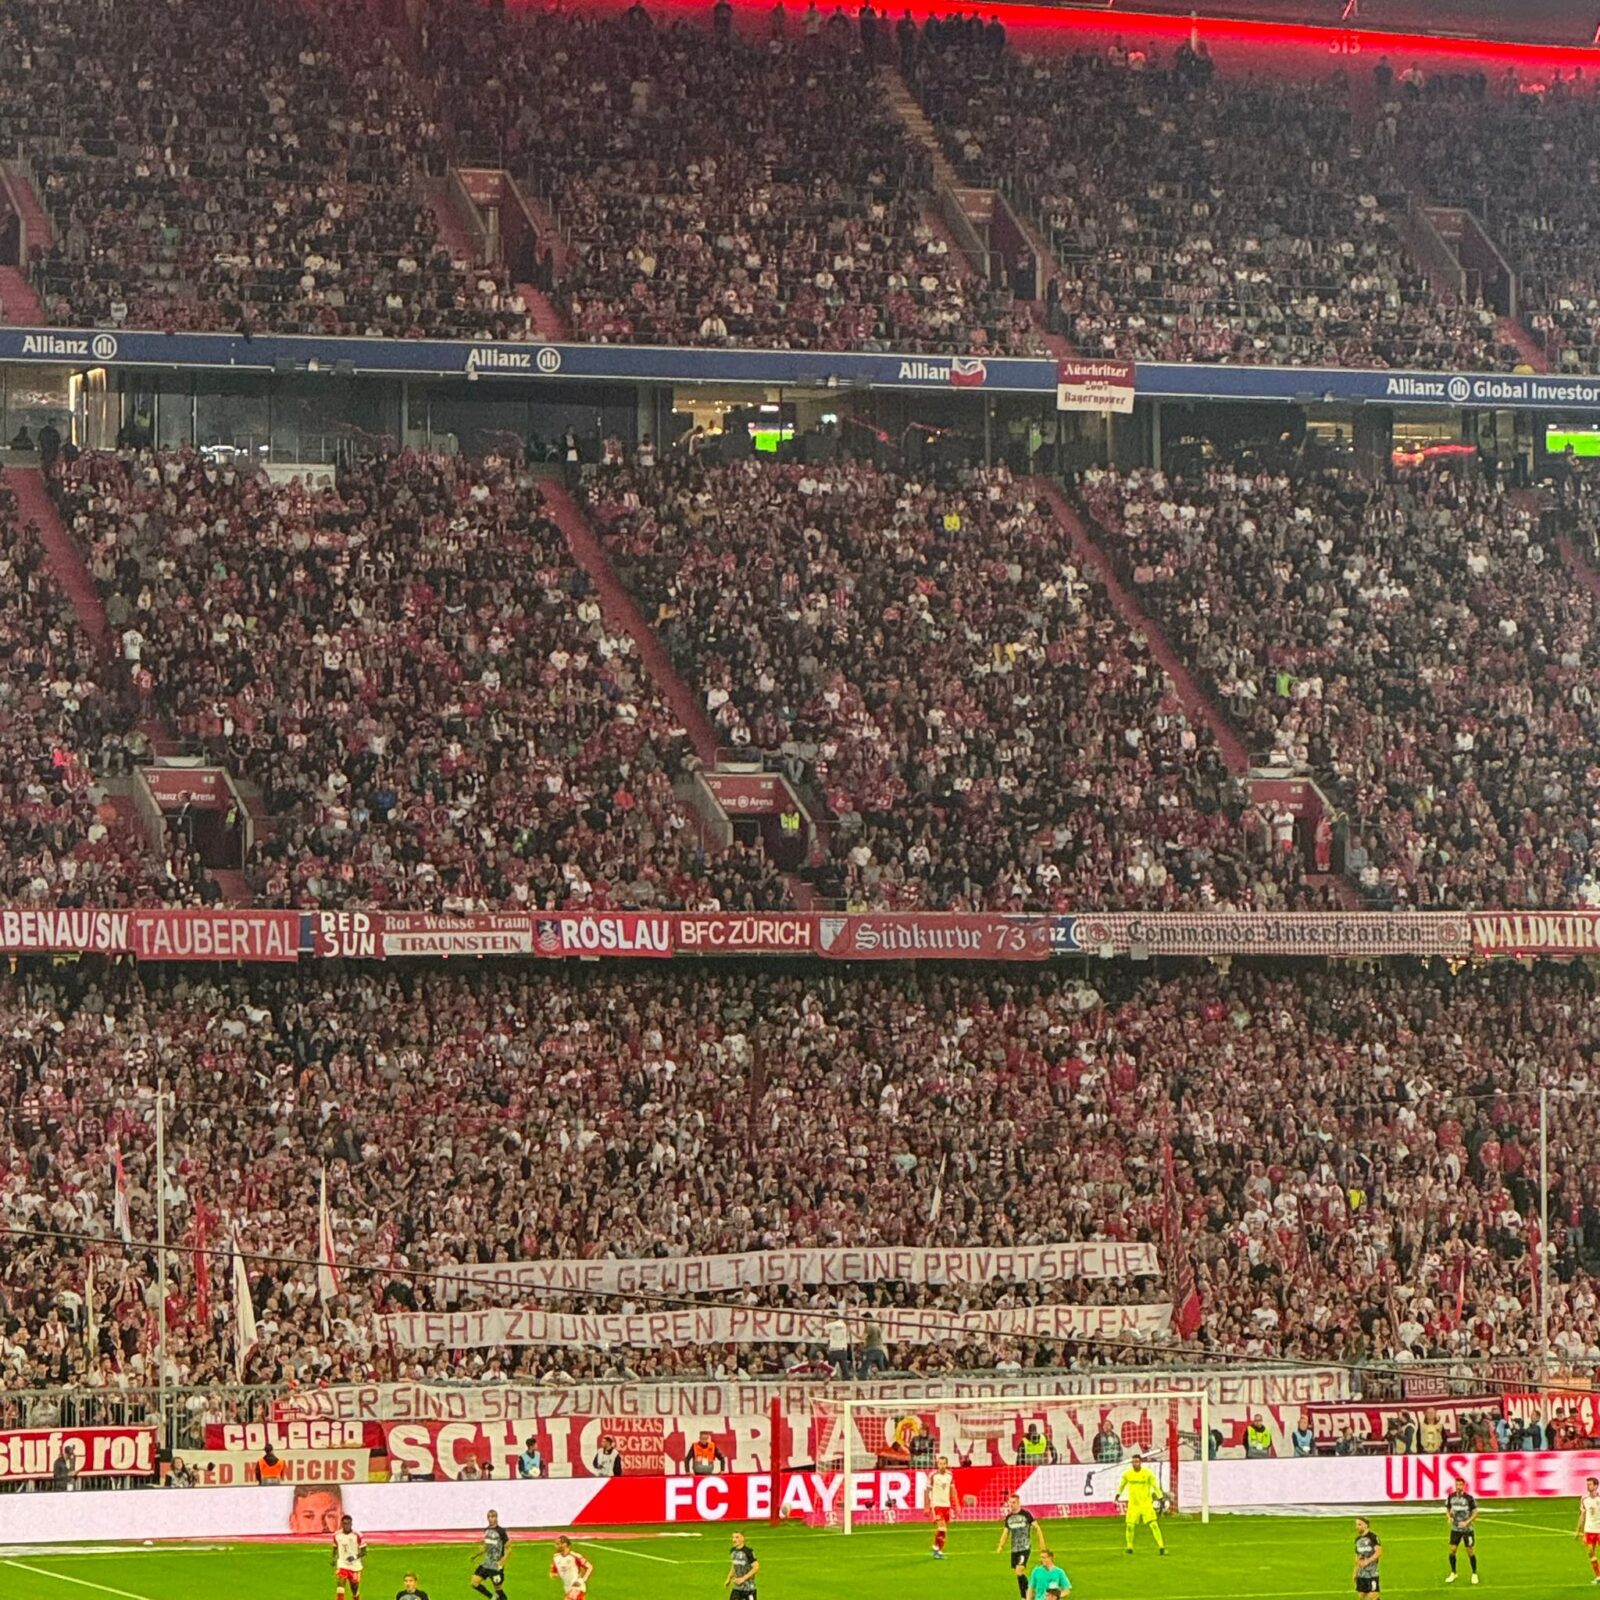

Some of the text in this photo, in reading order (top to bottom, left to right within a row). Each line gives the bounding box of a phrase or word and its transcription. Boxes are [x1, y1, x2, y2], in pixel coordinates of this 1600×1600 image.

[22, 335, 88, 354] Allianz
[466, 348, 531, 368] Allianz
[898, 362, 950, 380] Allian
[1387, 378, 1445, 396] Allianz
[1473, 380, 1527, 399] Global
[0, 911, 129, 949] BENAU/SN
[321, 912, 371, 932] RED
[385, 916, 411, 930] Rot
[424, 915, 475, 930] Weisse
[560, 915, 669, 950] RÖSLAU
[681, 918, 810, 946] BFC ZÜRICH
[855, 922, 982, 950] Südkurve
[1128, 919, 1423, 947] Commando Unterfranken
[1472, 915, 1600, 949] WALDKIR
[137, 918, 298, 956] TAUBERTAL
[323, 932, 376, 957] SUN
[397, 935, 522, 951] TRAUNSTEIN
[820, 1252, 912, 1284] KEINE
[504, 1311, 548, 1340] ZU
[560, 1310, 714, 1345] UNSEREN
[392, 1386, 466, 1419] SIND
[481, 1386, 639, 1419] SATZUNG
[655, 1386, 721, 1416] UND
[602, 1417, 663, 1432] ULTRAS
[92, 1431, 152, 1471] rot
[665, 1476, 729, 1521] FC
